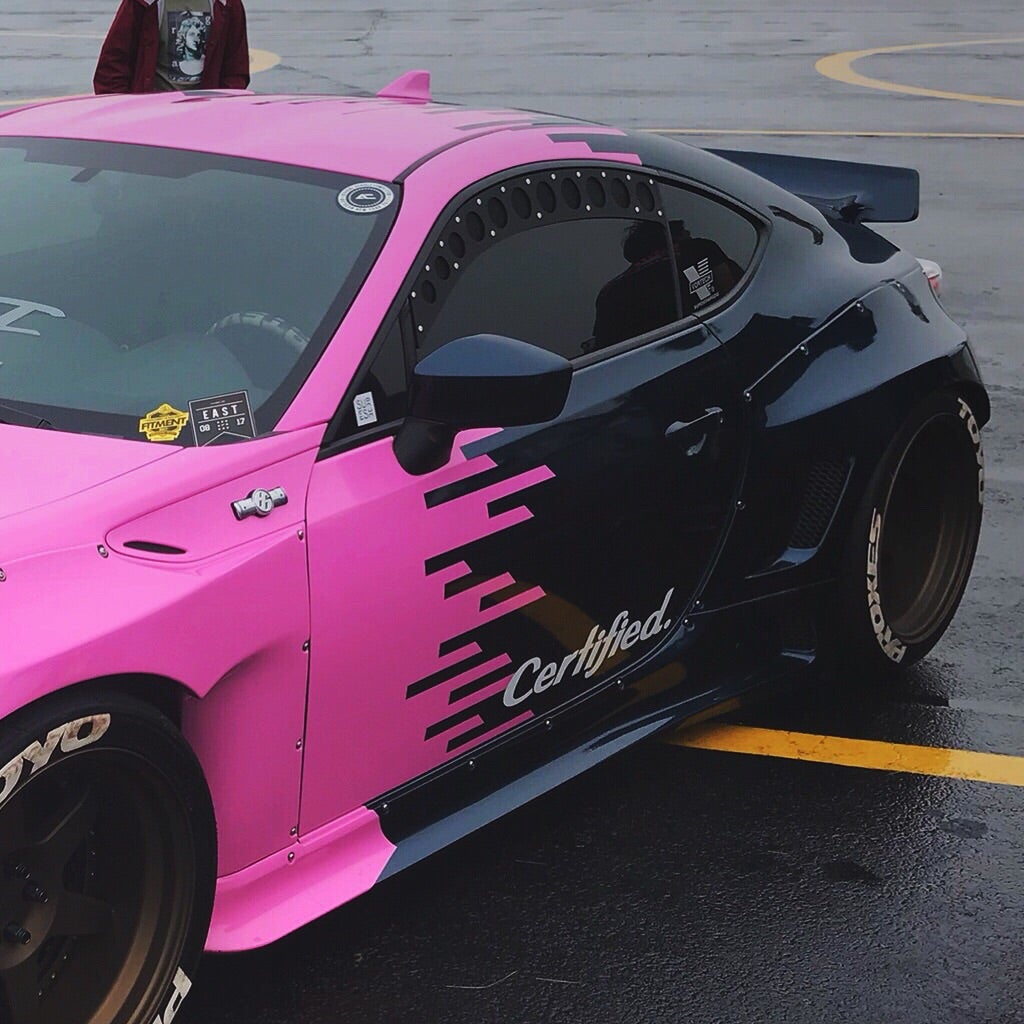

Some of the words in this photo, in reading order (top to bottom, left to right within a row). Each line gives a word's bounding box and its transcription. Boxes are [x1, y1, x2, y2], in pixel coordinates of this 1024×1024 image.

[202, 405, 238, 420] EAST
[141, 417, 187, 430] FITMENT
[236, 418, 246, 426] 17
[867, 507, 907, 664] PROXES
[503, 587, 675, 708] Certified.
